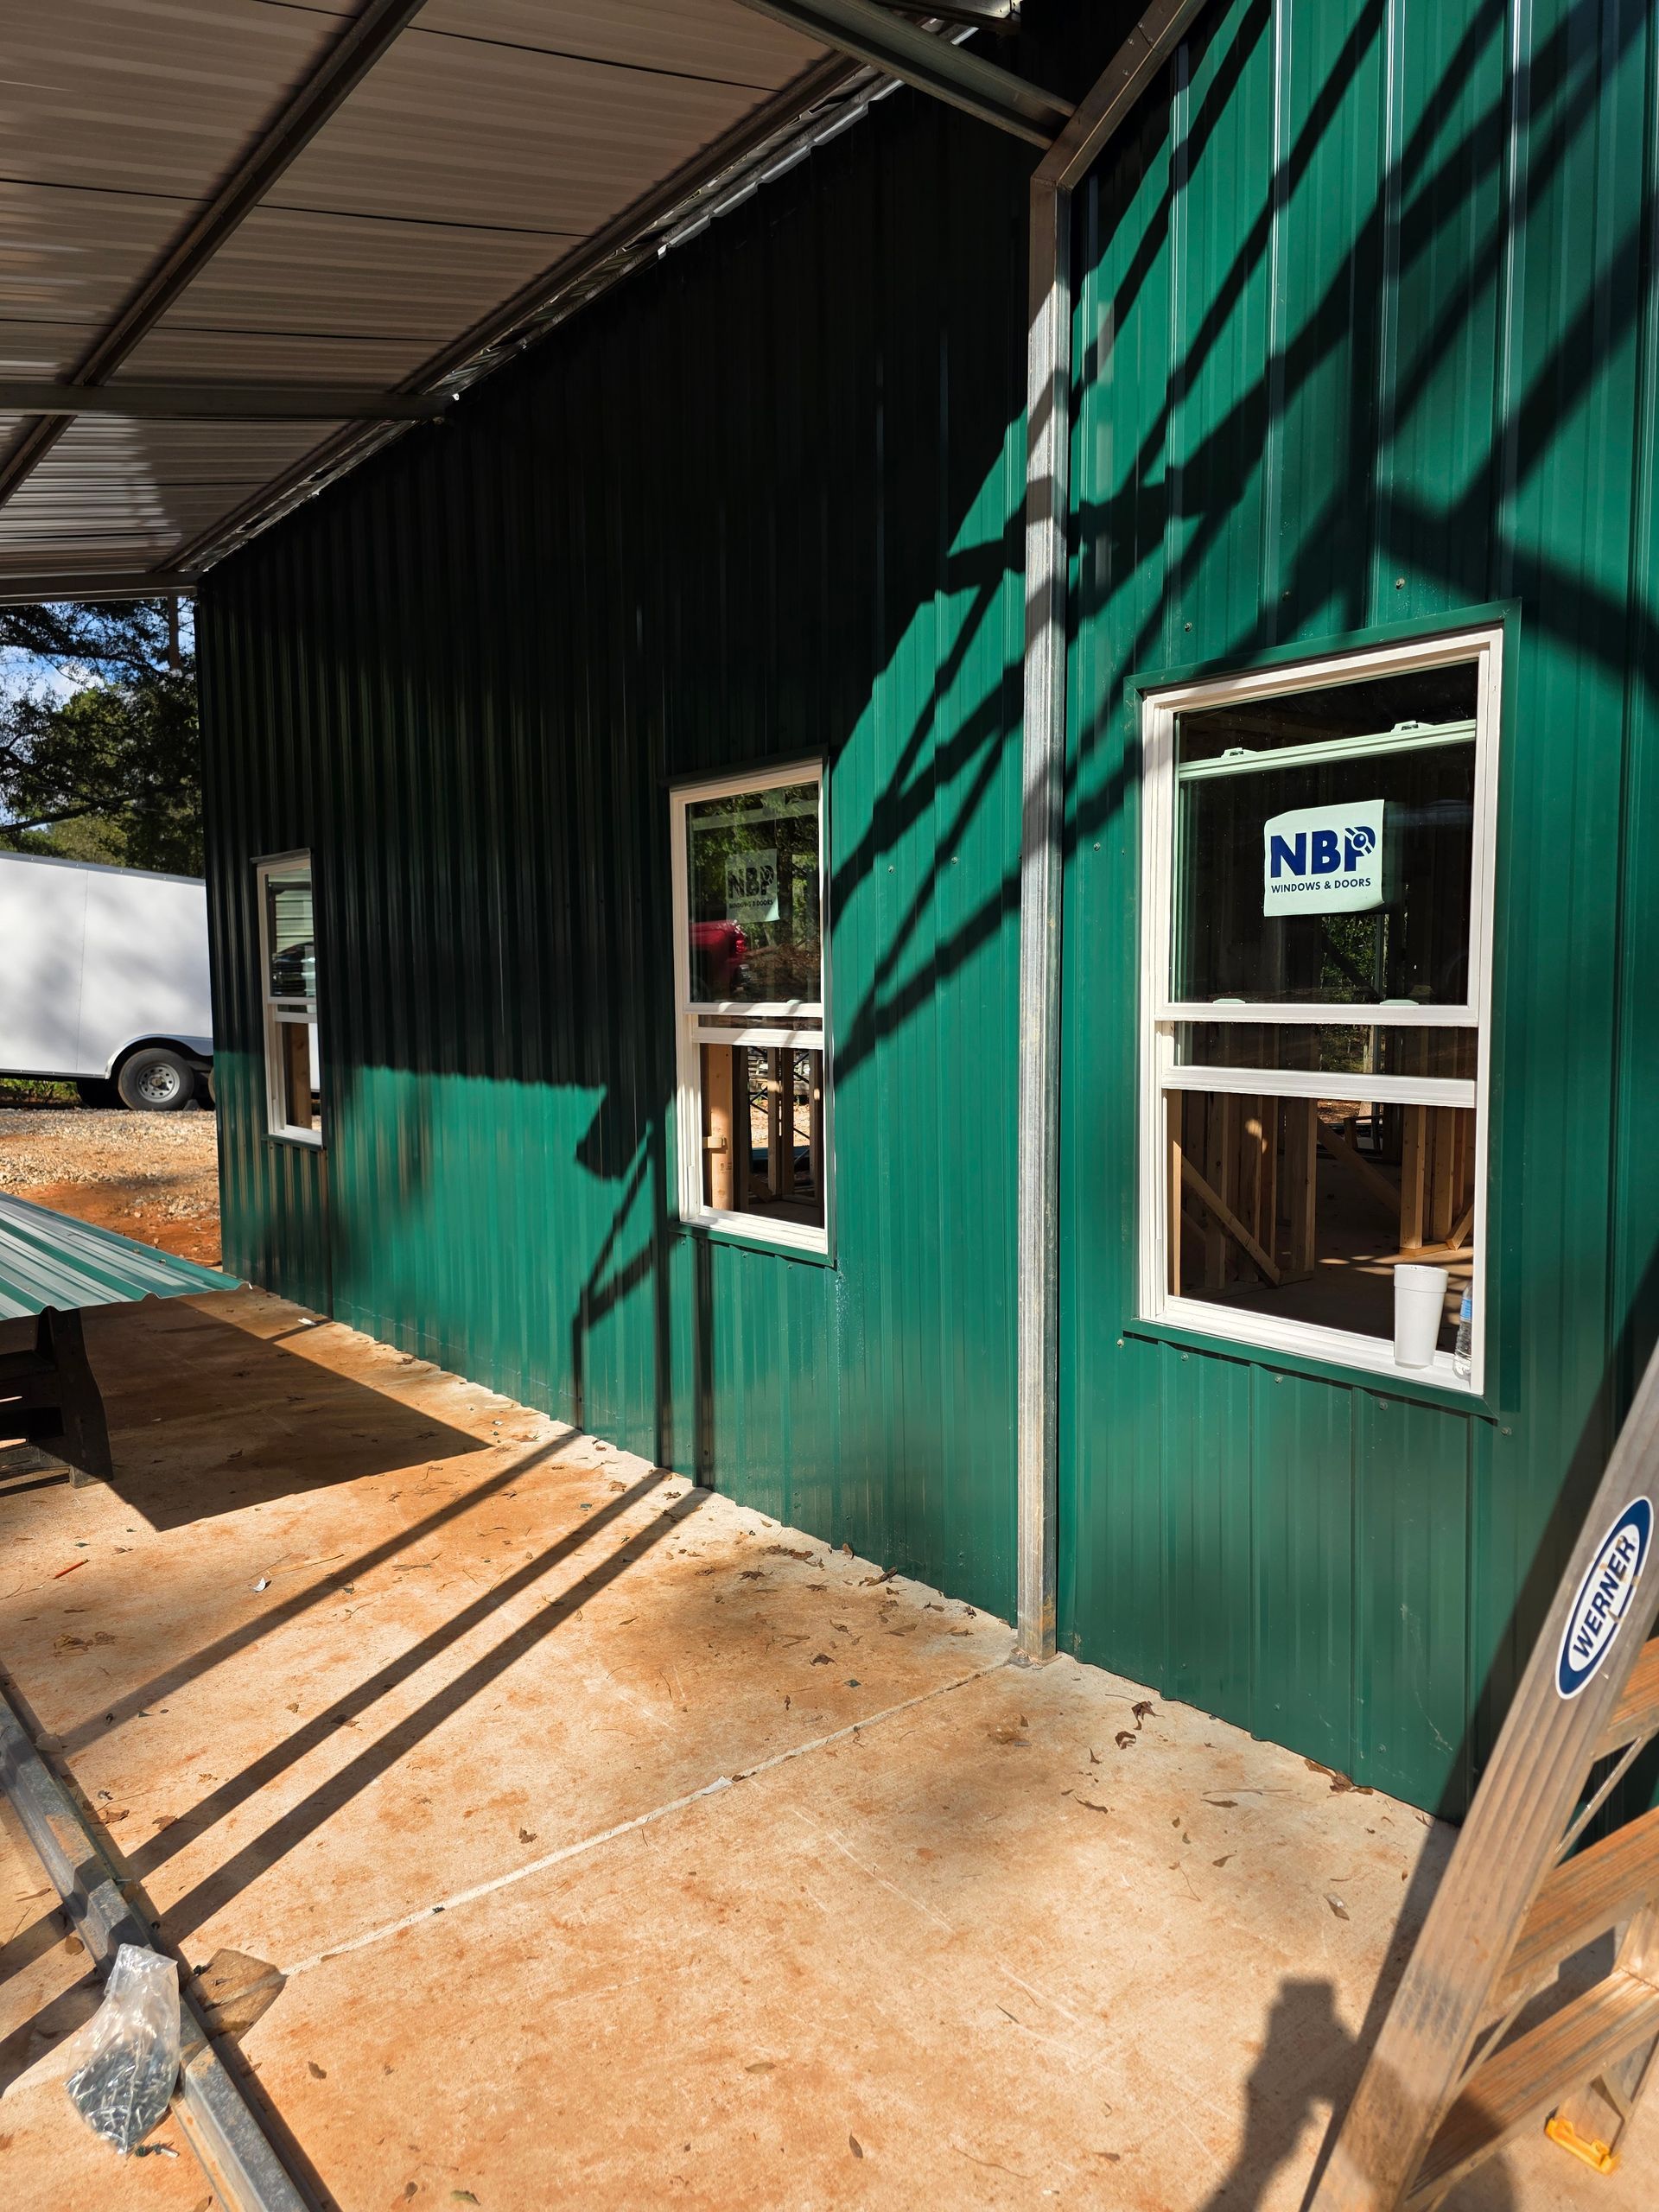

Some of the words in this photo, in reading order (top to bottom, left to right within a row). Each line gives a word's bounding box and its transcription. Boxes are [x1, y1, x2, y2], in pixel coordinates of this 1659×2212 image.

[1270, 826, 1376, 878] NBP
[728, 865, 774, 899] NBP
[1271, 881, 1321, 893] WINDOWS
[1334, 878, 1371, 889] DOORS
[1573, 1535, 1637, 1658] WERNER
